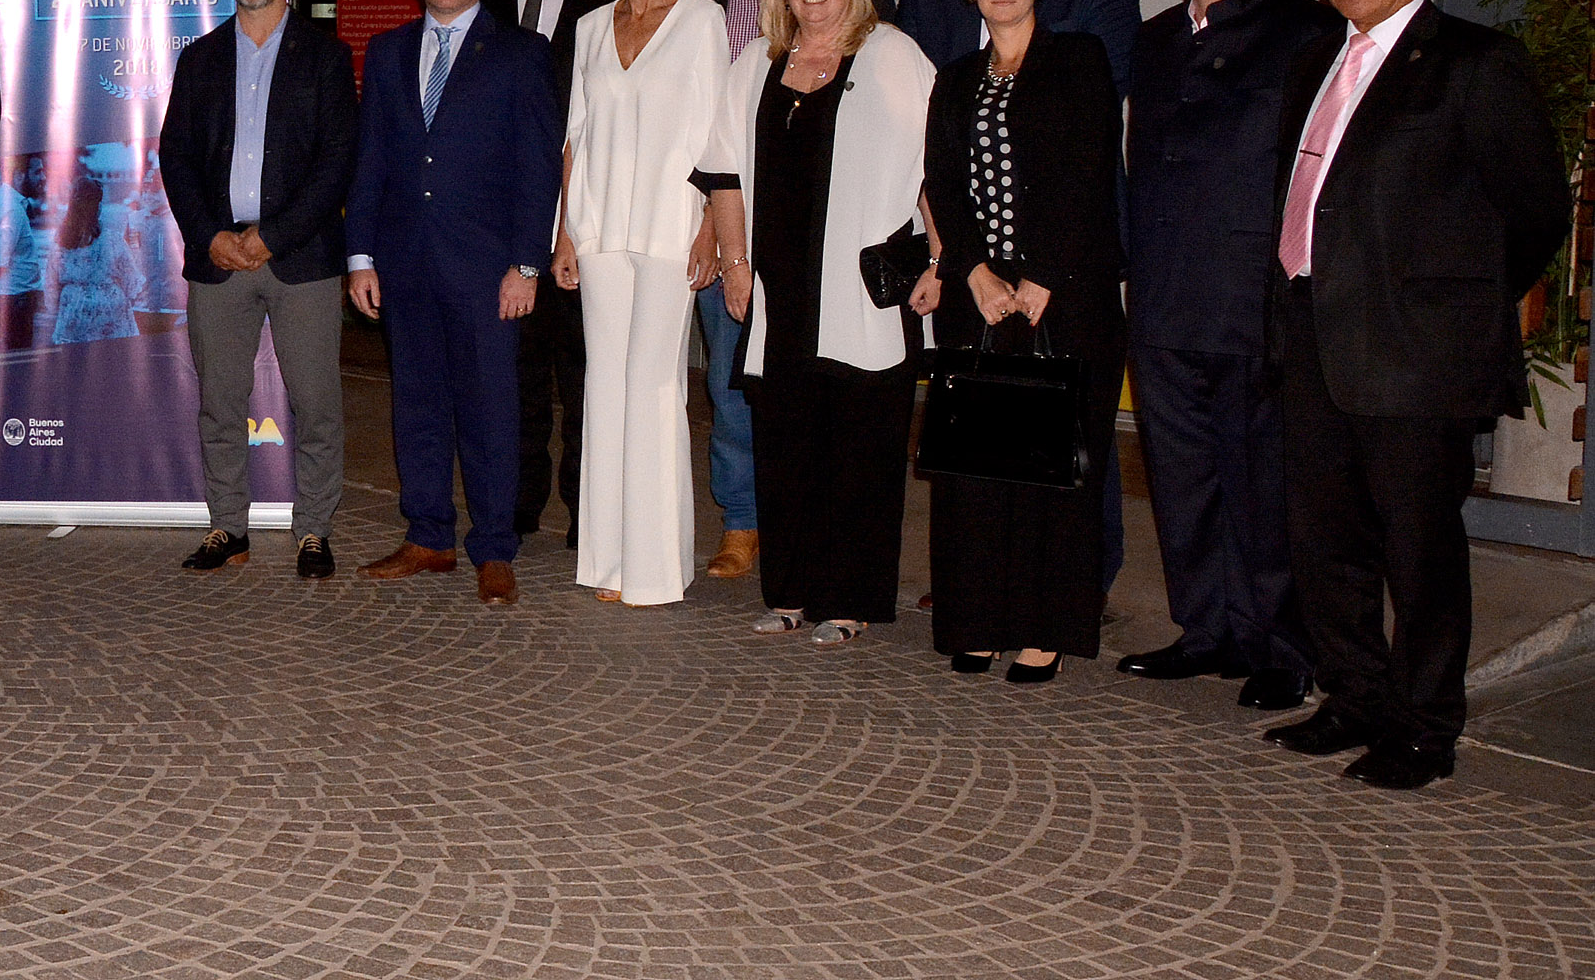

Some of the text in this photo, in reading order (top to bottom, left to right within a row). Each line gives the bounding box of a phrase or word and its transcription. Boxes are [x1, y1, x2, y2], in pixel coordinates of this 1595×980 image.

[93, 38, 112, 52] DE
[115, 35, 201, 52] NOVIMBR
[29, 418, 64, 427] Buenos
[29, 427, 55, 436] Aires
[29, 436, 64, 446] Ciudad
